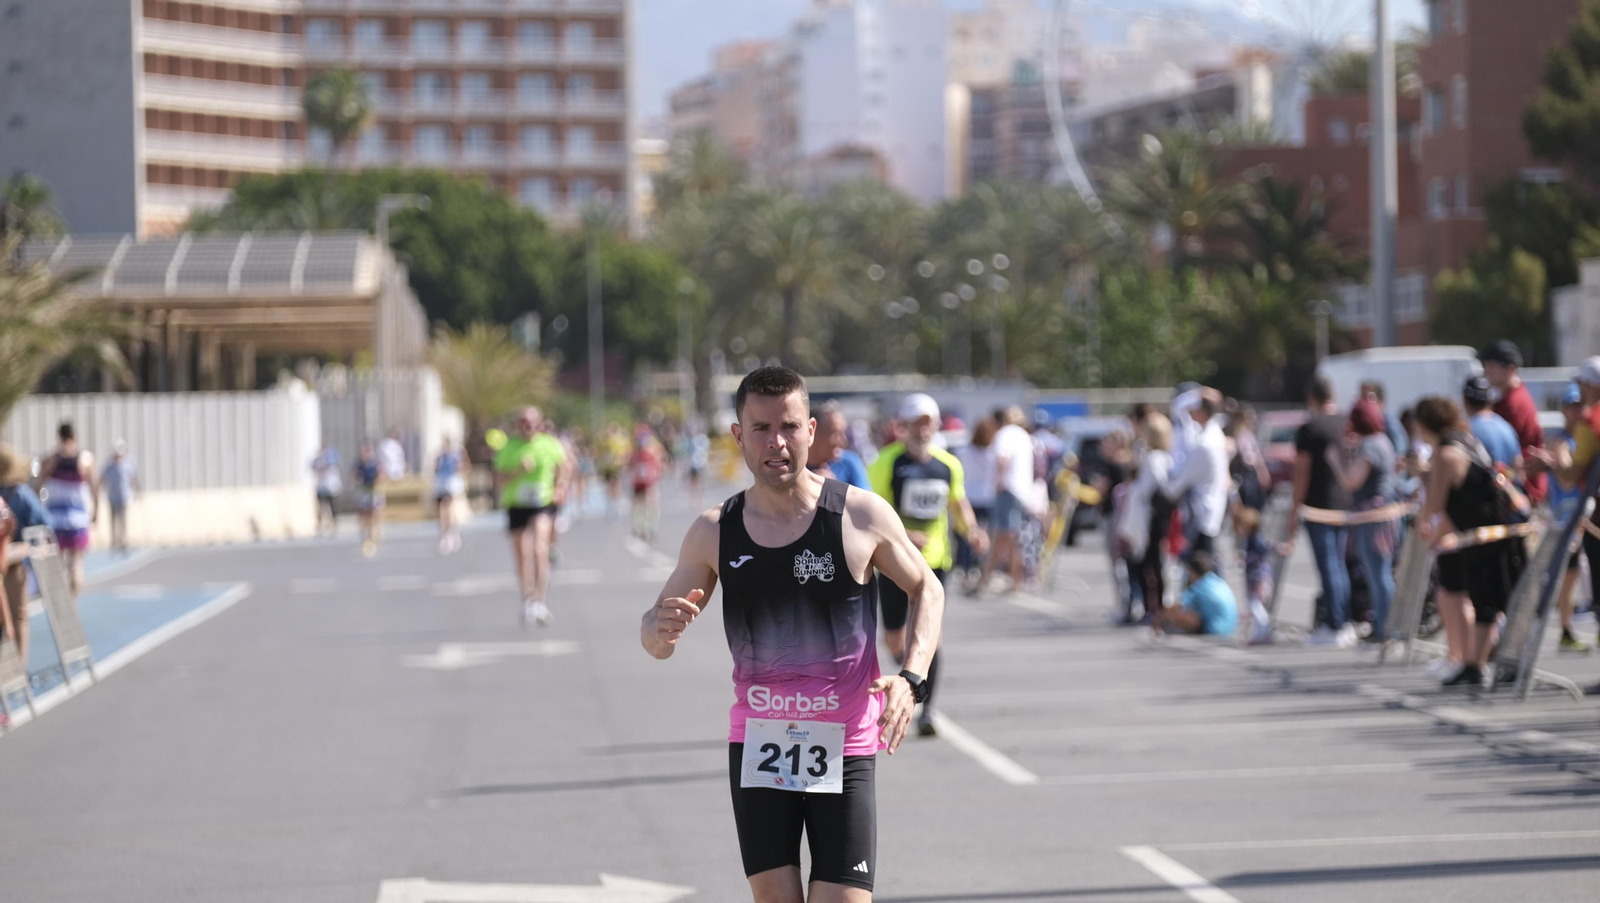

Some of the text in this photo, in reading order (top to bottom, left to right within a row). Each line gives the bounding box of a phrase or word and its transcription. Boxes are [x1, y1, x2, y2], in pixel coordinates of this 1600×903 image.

[795, 552, 832, 566] SORBAS
[794, 564, 835, 577] RUNNING
[747, 685, 840, 711] Sorbas
[757, 742, 828, 777] 213
